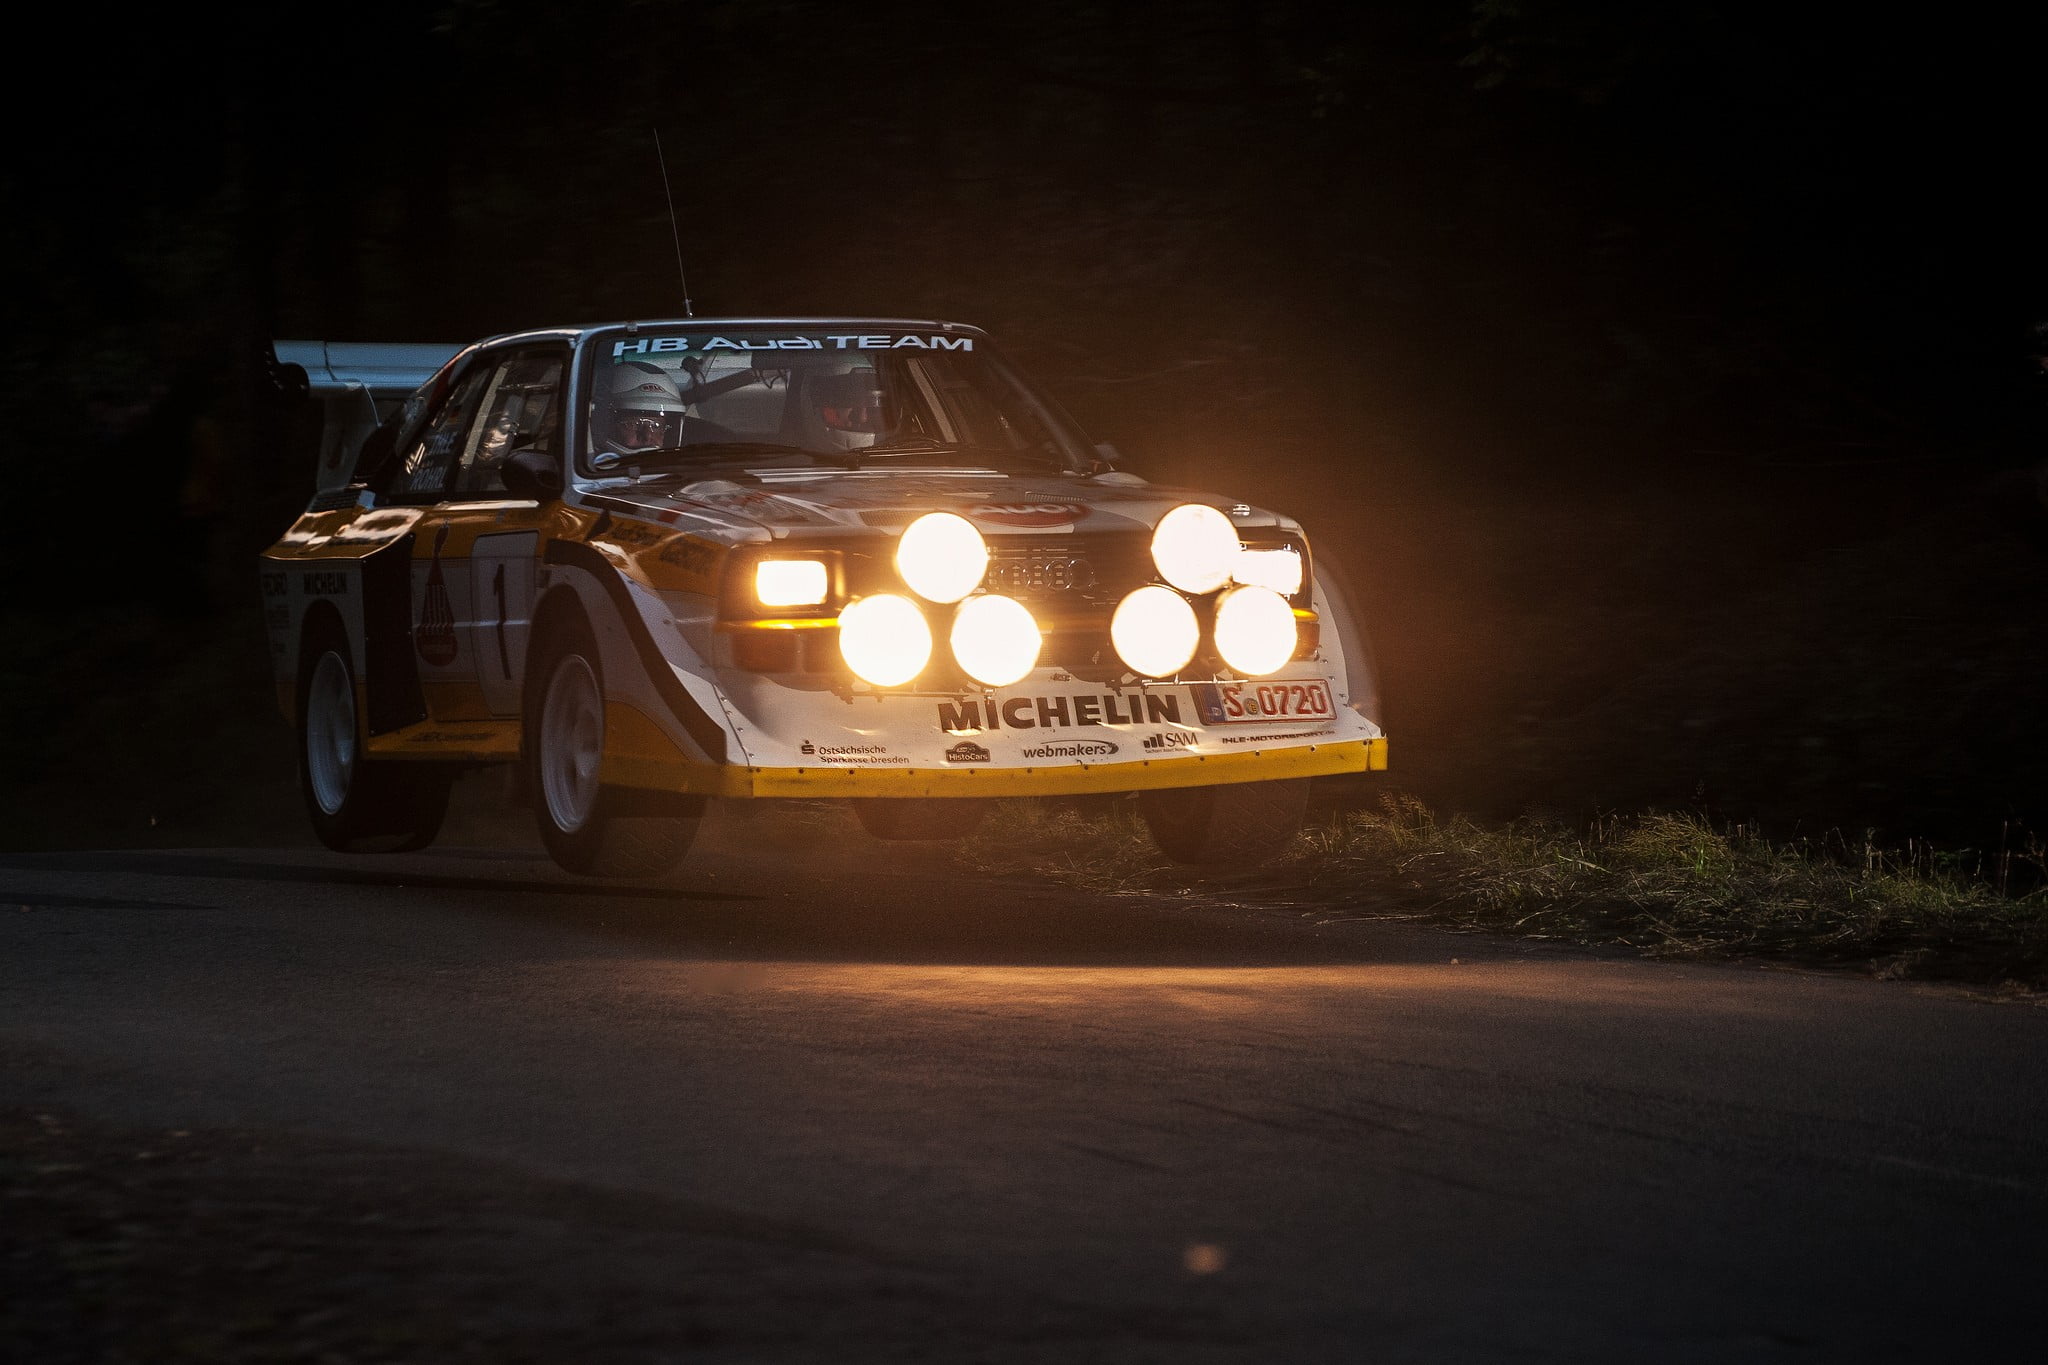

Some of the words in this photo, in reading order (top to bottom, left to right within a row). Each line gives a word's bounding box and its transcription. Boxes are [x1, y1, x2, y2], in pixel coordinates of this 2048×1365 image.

[612, 337, 689, 357] HB
[702, 336, 823, 350] Audi
[827, 335, 973, 351] TEAM
[493, 564, 511, 680] 1
[1222, 686, 1245, 717] S
[1256, 685, 1329, 716] 0720
[937, 694, 1182, 732] MICHELIN
[1165, 732, 1199, 747] SAM
[819, 745, 887, 755] Ostsächsische
[1023, 743, 1107, 758] webmakers
[820, 756, 869, 765] Sparkasse
[871, 756, 910, 764] Dresden
